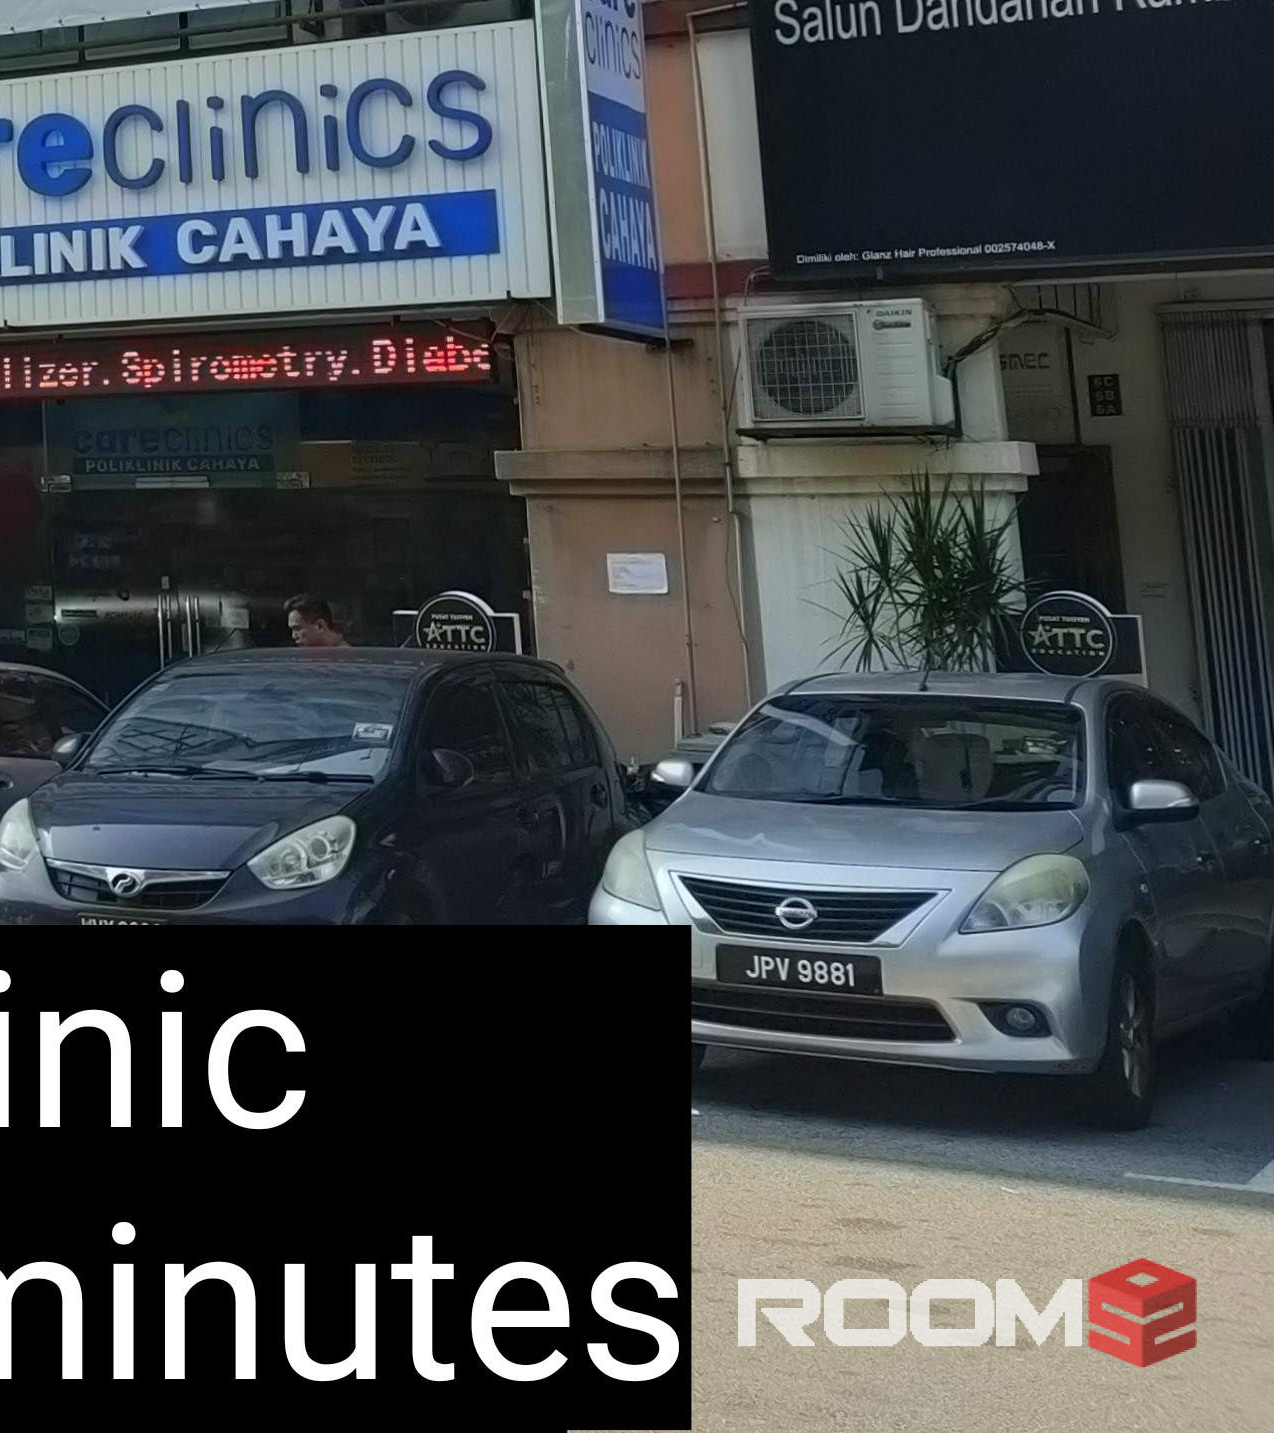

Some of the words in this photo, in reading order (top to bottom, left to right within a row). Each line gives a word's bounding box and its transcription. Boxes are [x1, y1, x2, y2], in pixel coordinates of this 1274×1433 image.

[584, 10, 642, 82] clinics
[592, 118, 650, 190] POLIKLINIK
[175, 201, 444, 267] CAHAYA
[599, 188, 658, 272] CAHAYA
[861, 250, 892, 261] Glanz
[894, 248, 916, 259] Hair
[918, 245, 983, 258] Professional
[876, 308, 913, 317] DAIKIN
[85, 457, 182, 473] POLIKLINIK
[186, 457, 261, 471] CAHAYA
[745, 955, 790, 981] JPV
[797, 959, 855, 987] 9881
